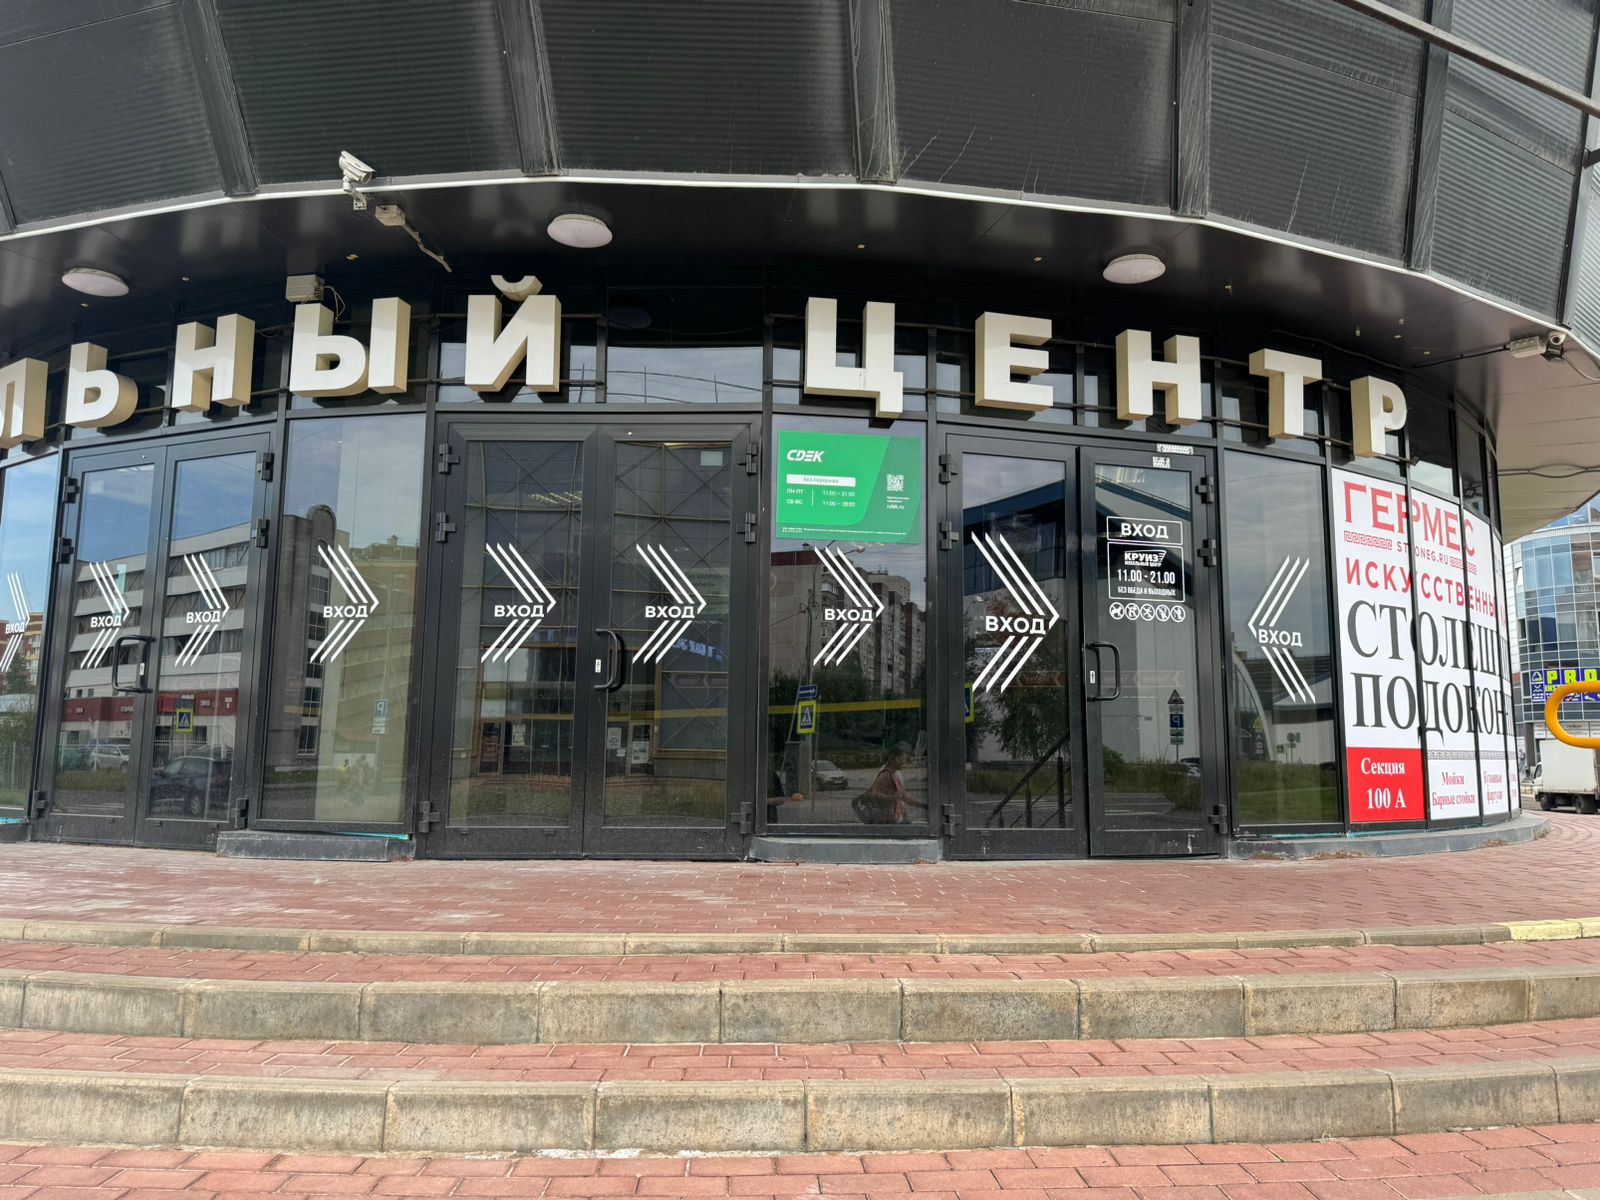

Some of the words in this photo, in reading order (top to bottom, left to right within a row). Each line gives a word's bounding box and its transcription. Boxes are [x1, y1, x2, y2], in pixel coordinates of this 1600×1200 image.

[804, 296, 1408, 458] ЦЕНТР
[786, 449, 825, 463] CDEK
[1343, 480, 1476, 557] ГЕРМЕС
[1121, 522, 1169, 539] ВХОД
[1124, 552, 1159, 562] КРУИЗ
[1117, 568, 1142, 582] 11.00
[1150, 570, 1176, 585] 21.00
[1117, 586, 1127, 594] БЕЗ
[1127, 587, 1143, 595] ОБЕДА
[1143, 587, 1147, 595] И
[1148, 588, 1176, 596] ВЫХОДНЫХ
[186, 610, 221, 624] ВХОД
[323, 604, 369, 619] ВХОД
[493, 604, 545, 619] ВХОД
[644, 605, 695, 619] ВХОД
[824, 607, 874, 623] ВХОД
[5, 621, 25, 634] ВХОД
[91, 615, 122, 629] ВХОД
[984, 615, 1047, 635] ВХОД
[1258, 628, 1303, 647] ВХОД
[1360, 756, 1406, 776] Секция
[1441, 771, 1465, 785] Мойки
[1367, 787, 1391, 809] 100
[1431, 792, 1455, 809] Барные
[1455, 790, 1476, 805] стойки
